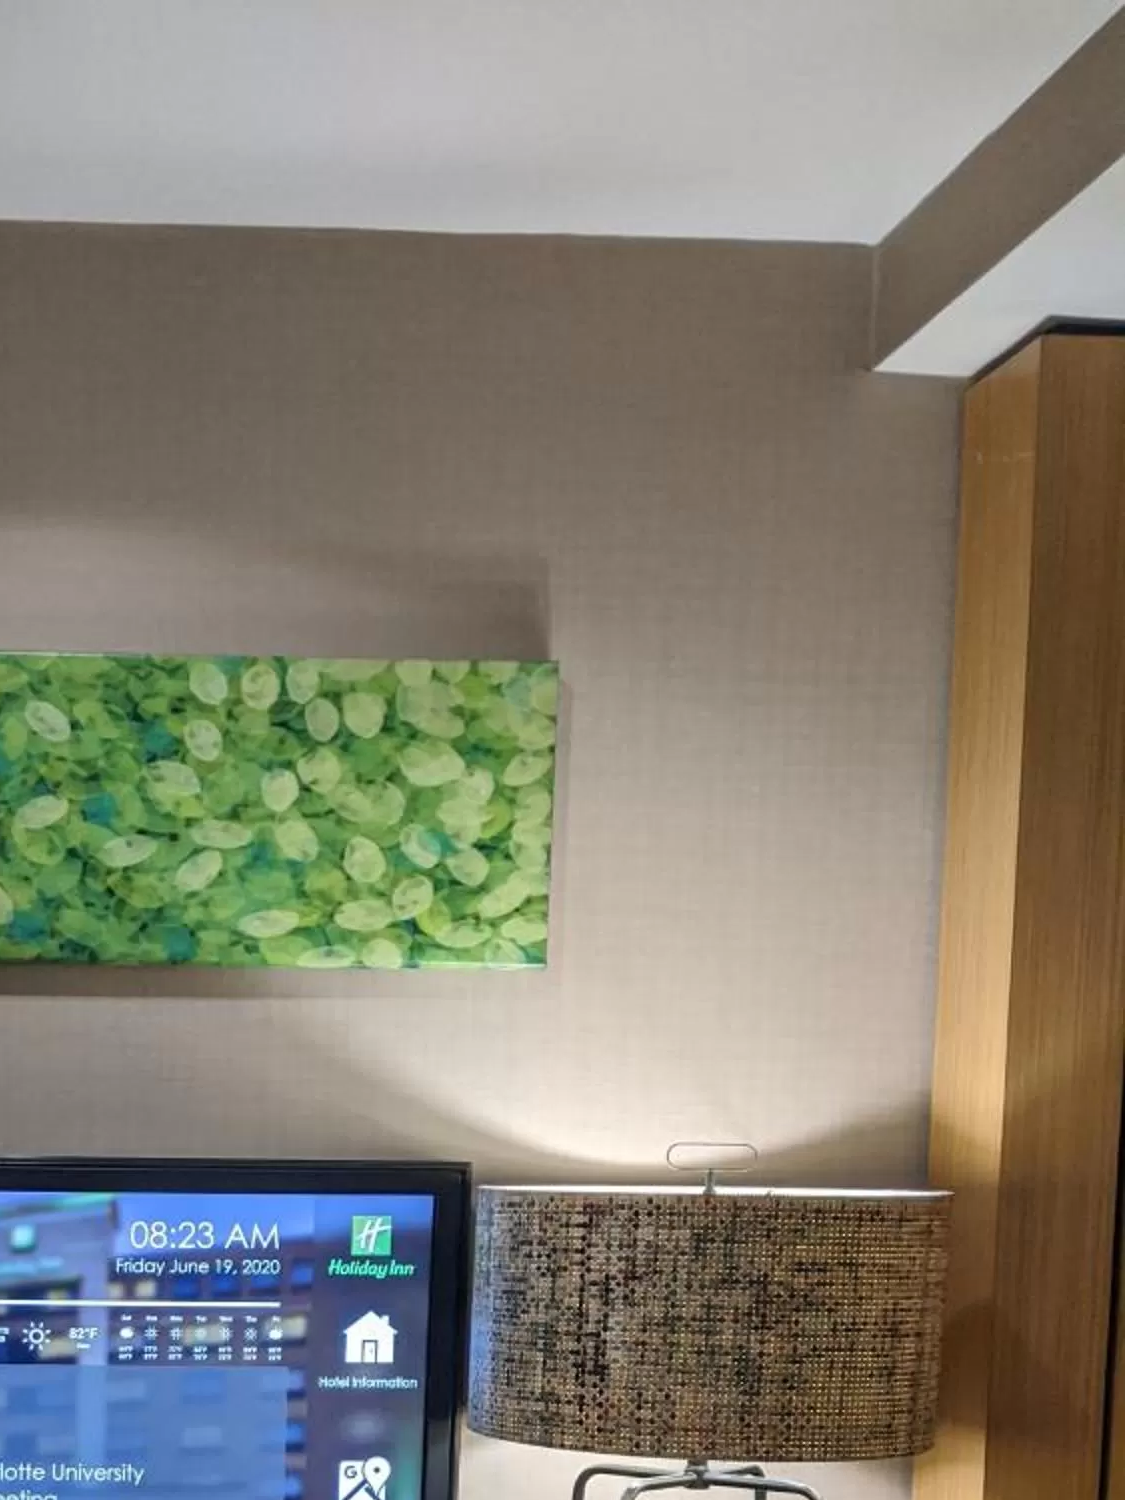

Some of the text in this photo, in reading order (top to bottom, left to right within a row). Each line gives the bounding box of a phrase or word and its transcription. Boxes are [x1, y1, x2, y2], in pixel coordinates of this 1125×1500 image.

[129, 1220, 280, 1249] 08:23 AM
[115, 1257, 281, 1277] Friday June 19, 2020
[328, 1258, 416, 1279] Holiday Inn
[318, 1376, 418, 1389] Hotel Information
[52, 1463, 145, 1486] University
